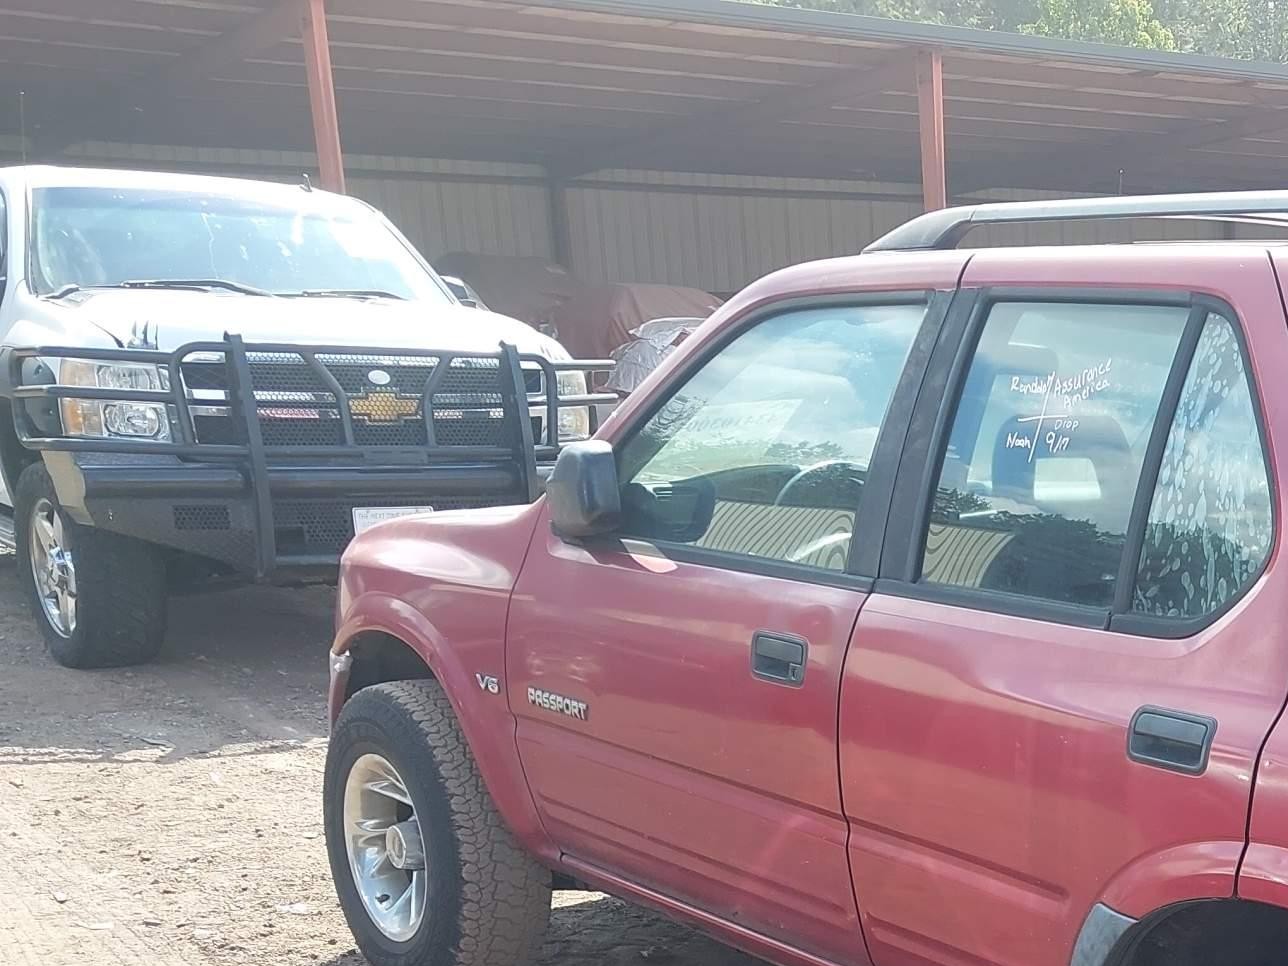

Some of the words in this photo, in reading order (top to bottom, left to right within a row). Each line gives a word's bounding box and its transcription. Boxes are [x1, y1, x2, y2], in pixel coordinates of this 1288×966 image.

[1053, 357, 1112, 397] Assurance
[1063, 379, 1111, 408] America
[1054, 418, 1079, 431] Drop
[1006, 431, 1031, 448] Noah
[474, 672, 501, 695] V6
[526, 686, 588, 721] PASSPORT
